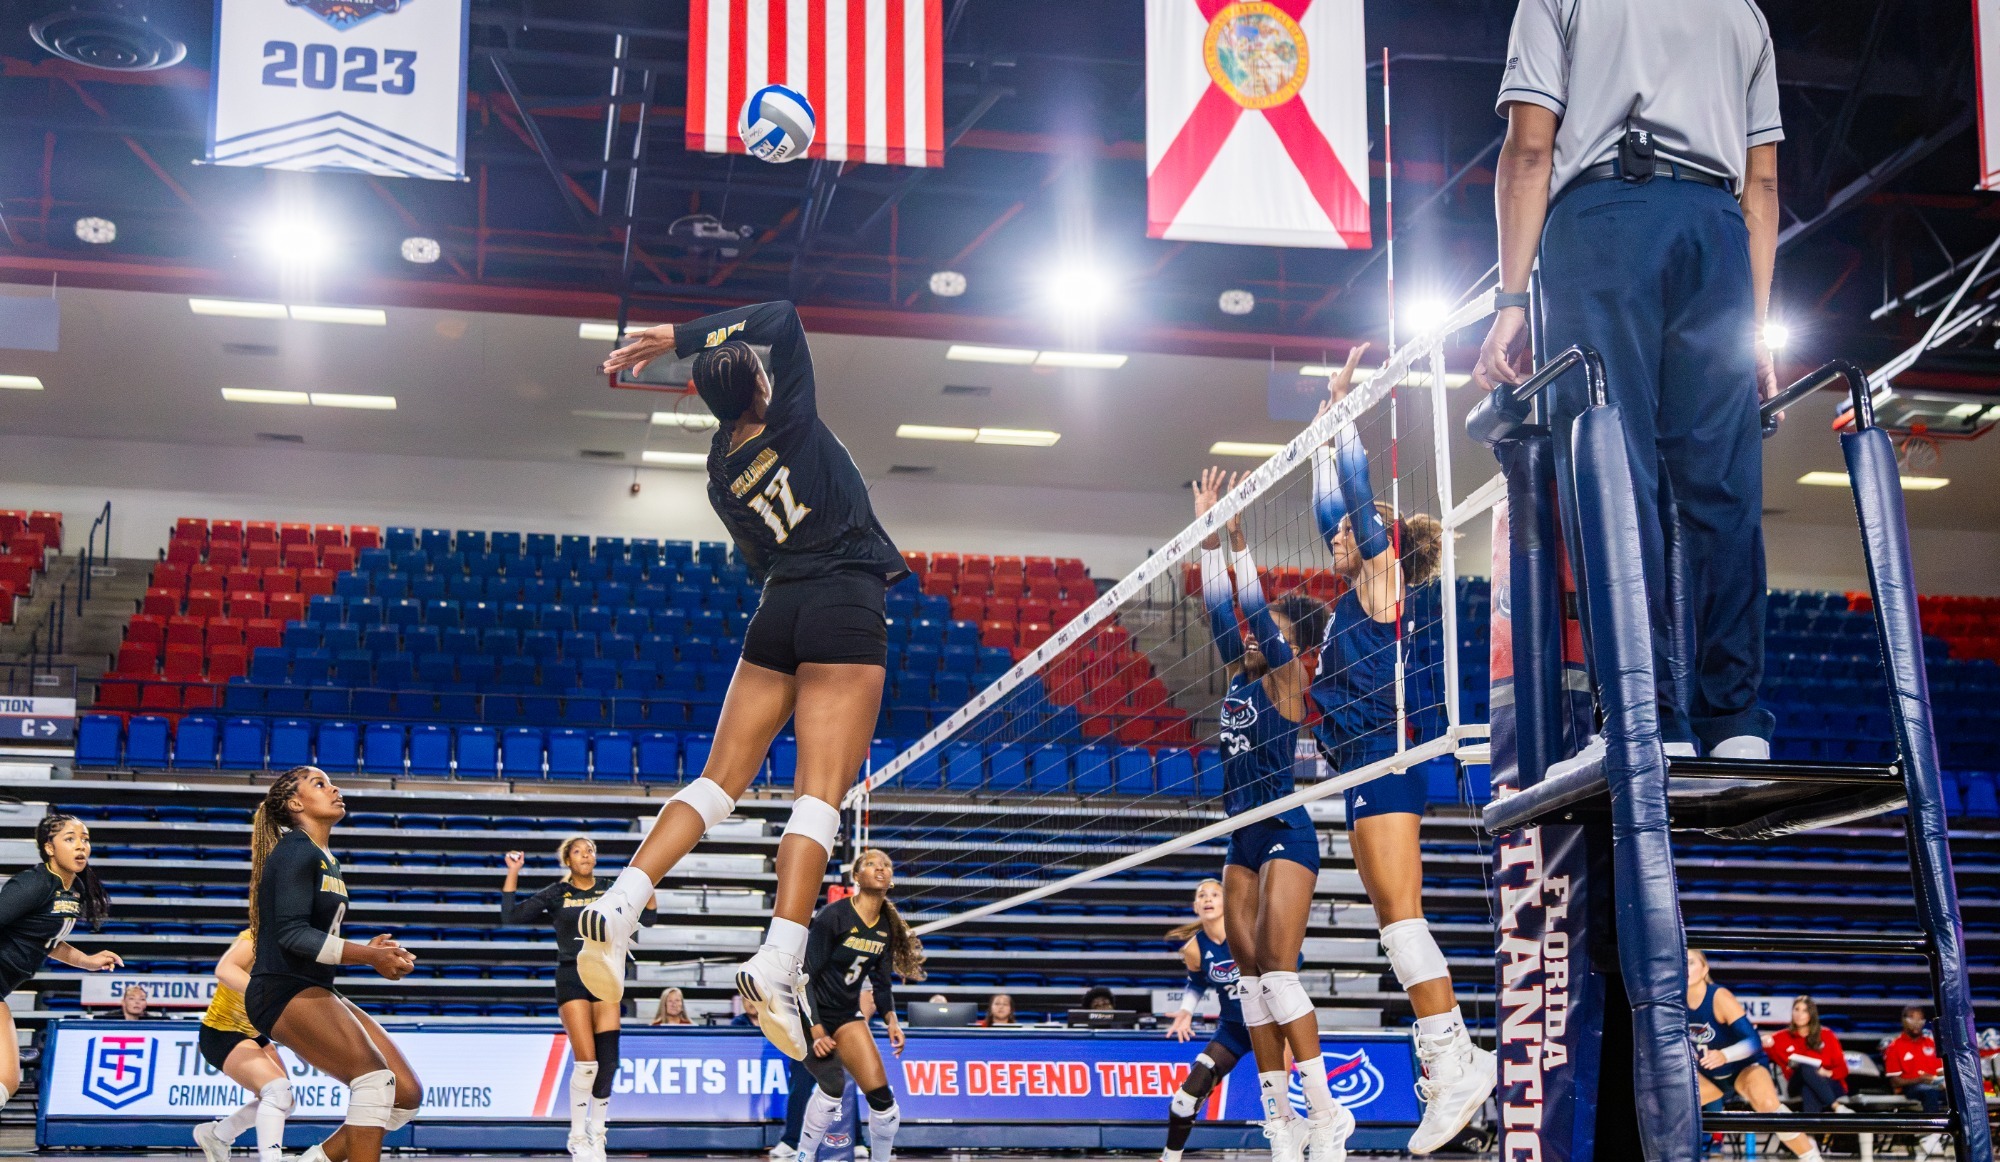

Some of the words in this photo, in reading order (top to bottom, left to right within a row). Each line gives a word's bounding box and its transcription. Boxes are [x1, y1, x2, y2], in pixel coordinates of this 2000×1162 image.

[262, 40, 417, 95] 2023
[22, 718, 35, 737] C
[844, 955, 869, 986] 5
[1543, 874, 1570, 1070] FLORIDA
[111, 980, 199, 998] STION
[613, 1058, 726, 1094] CKETS
[902, 1061, 959, 1096] WE
[966, 1061, 1092, 1097] DEFEND
[169, 1085, 246, 1106] CRIMINAL
[331, 1086, 341, 1107] &
